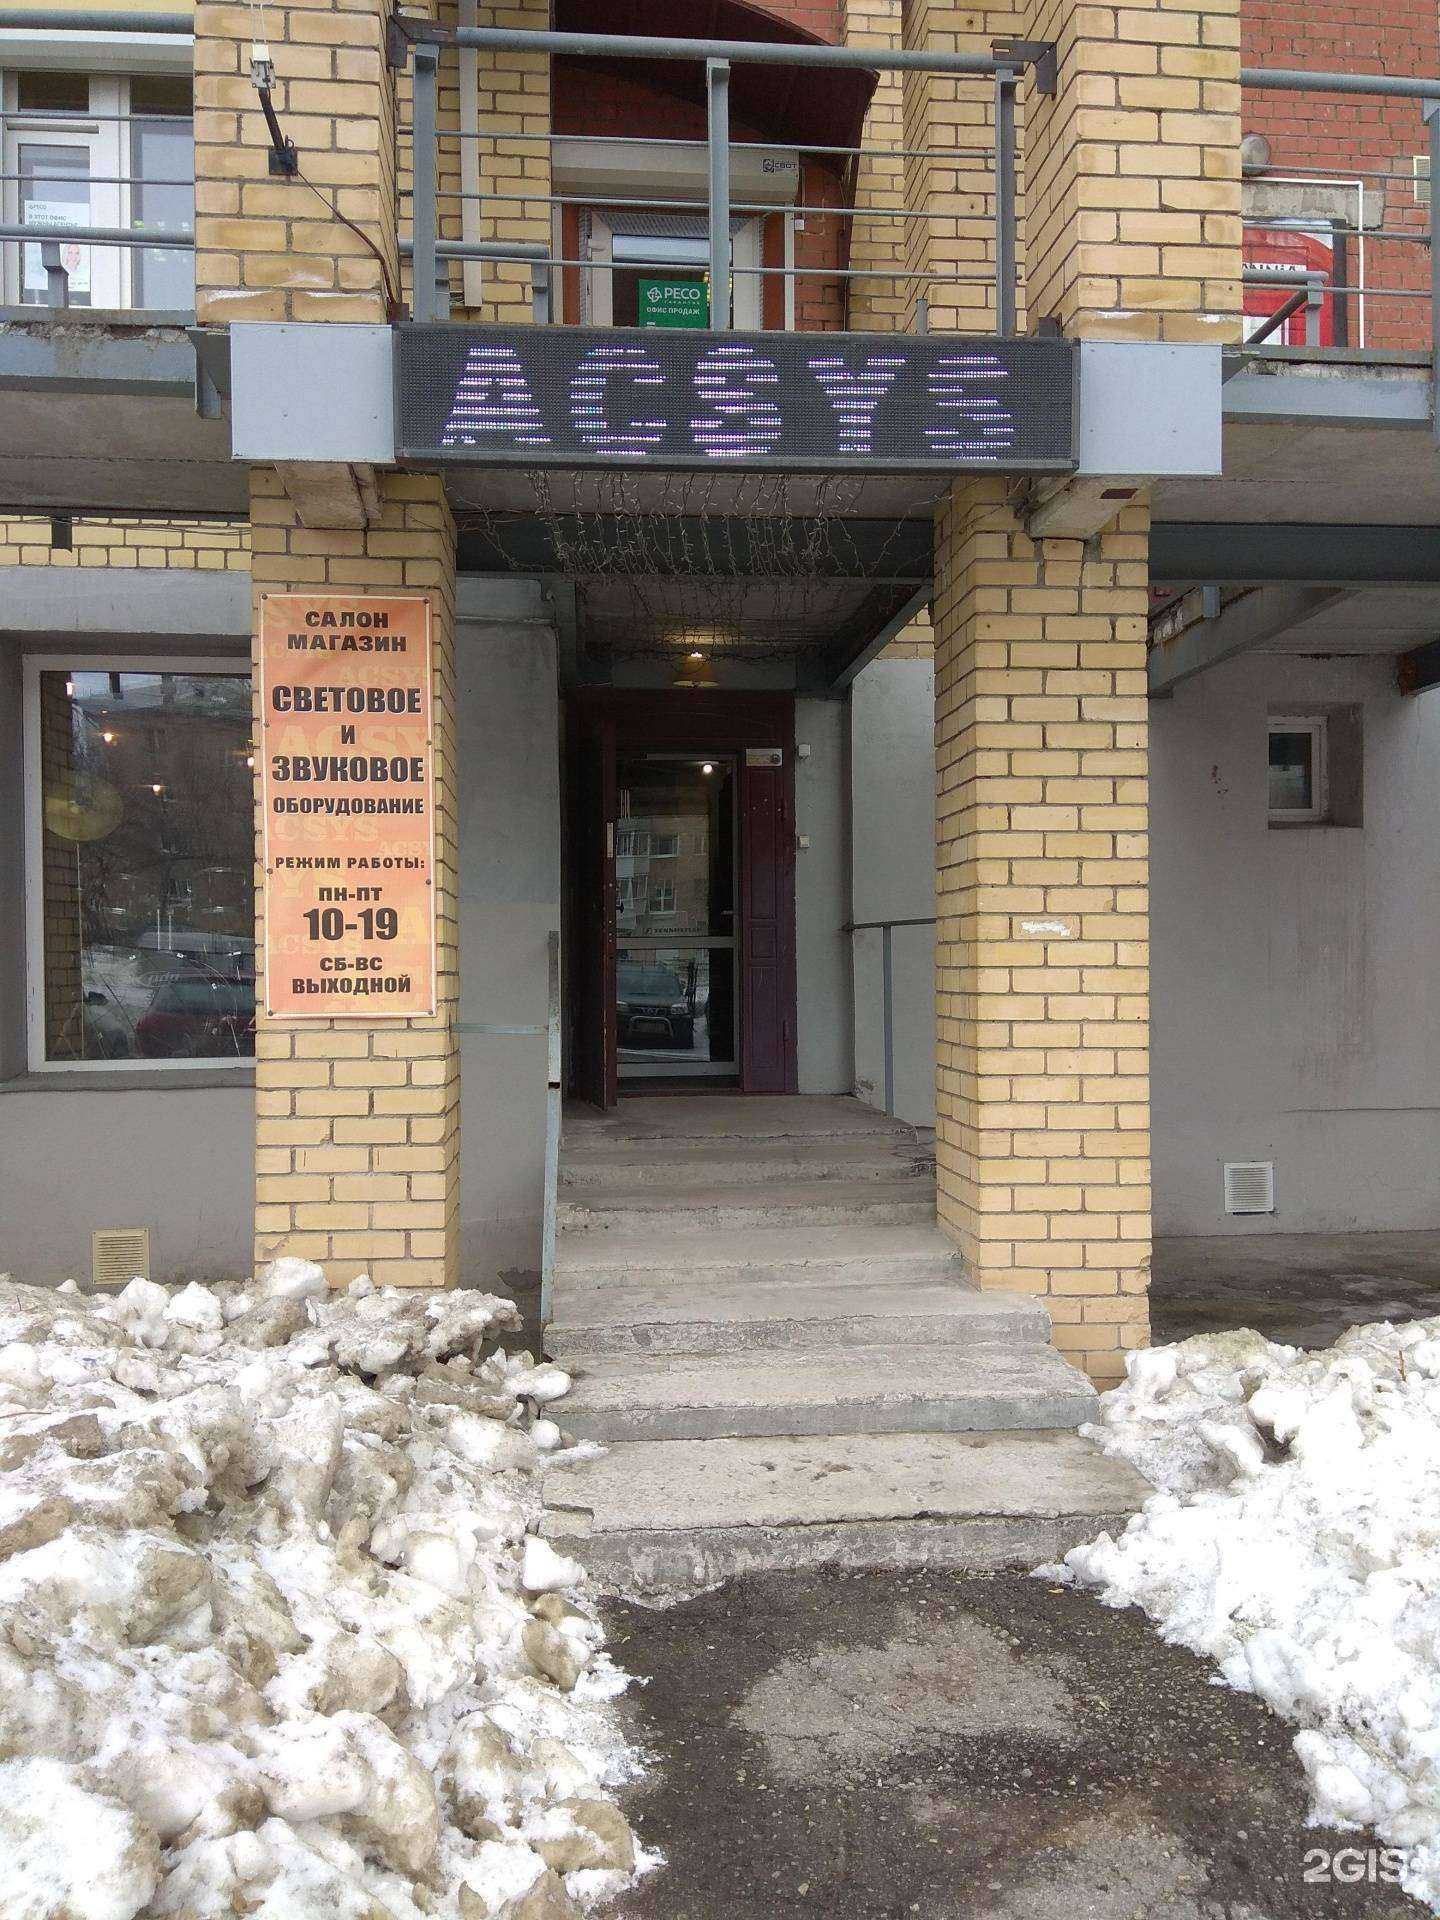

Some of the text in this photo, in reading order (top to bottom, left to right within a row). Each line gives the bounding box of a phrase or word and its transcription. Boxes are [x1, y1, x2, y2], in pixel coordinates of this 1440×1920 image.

[664, 287, 700, 299] РЕСО
[668, 308, 700, 316] ПРОДАЖ
[440, 346, 1017, 461] ACSYS
[305, 611, 389, 629] САЛОН
[287, 633, 407, 652] МАГАЗИН
[272, 685, 422, 714] СВЕТОВОЕ
[341, 724, 356, 745] И
[272, 755, 425, 783] ЗВУКОВОЕ
[273, 797, 425, 816] ОБОРУДОВАНИЕ
[275, 857, 425, 869] РЕЖИМ РАБОТЫ:
[318, 887, 383, 901] ПН-ПТ
[303, 907, 398, 941] 10-19
[319, 957, 383, 972] СБ-ВС
[292, 974, 411, 996] ВЫХОДНОЙ
